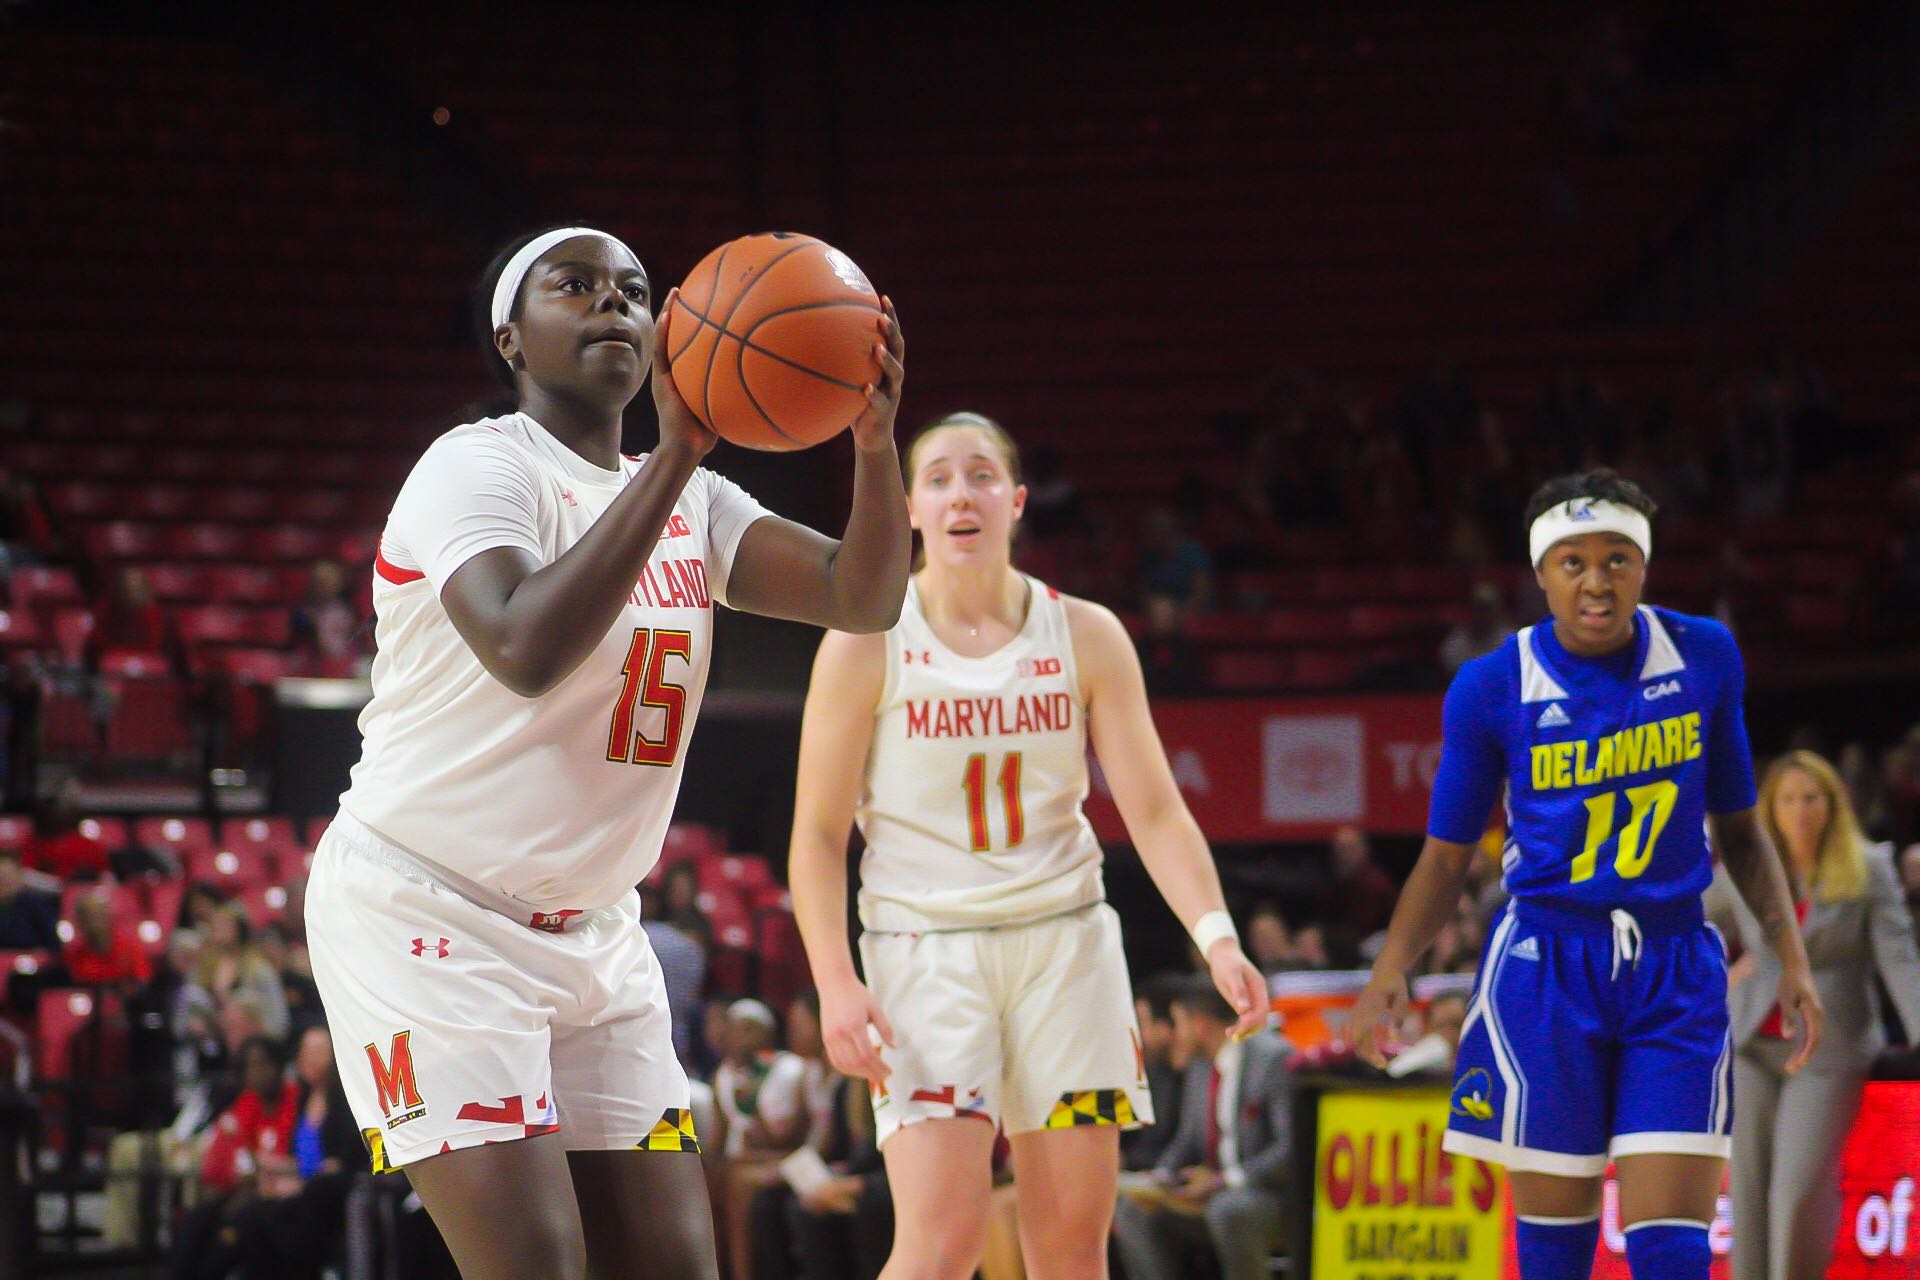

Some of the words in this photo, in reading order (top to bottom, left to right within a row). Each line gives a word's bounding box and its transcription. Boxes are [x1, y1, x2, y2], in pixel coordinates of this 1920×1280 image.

[606, 627, 692, 767] 15
[906, 692, 1071, 739] MARYLAND
[1643, 679, 1682, 701] CAA
[1530, 712, 1702, 791] DELAWARE
[961, 751, 1024, 852] 11
[1570, 780, 1679, 884] 10
[1856, 1176, 1914, 1257] of
